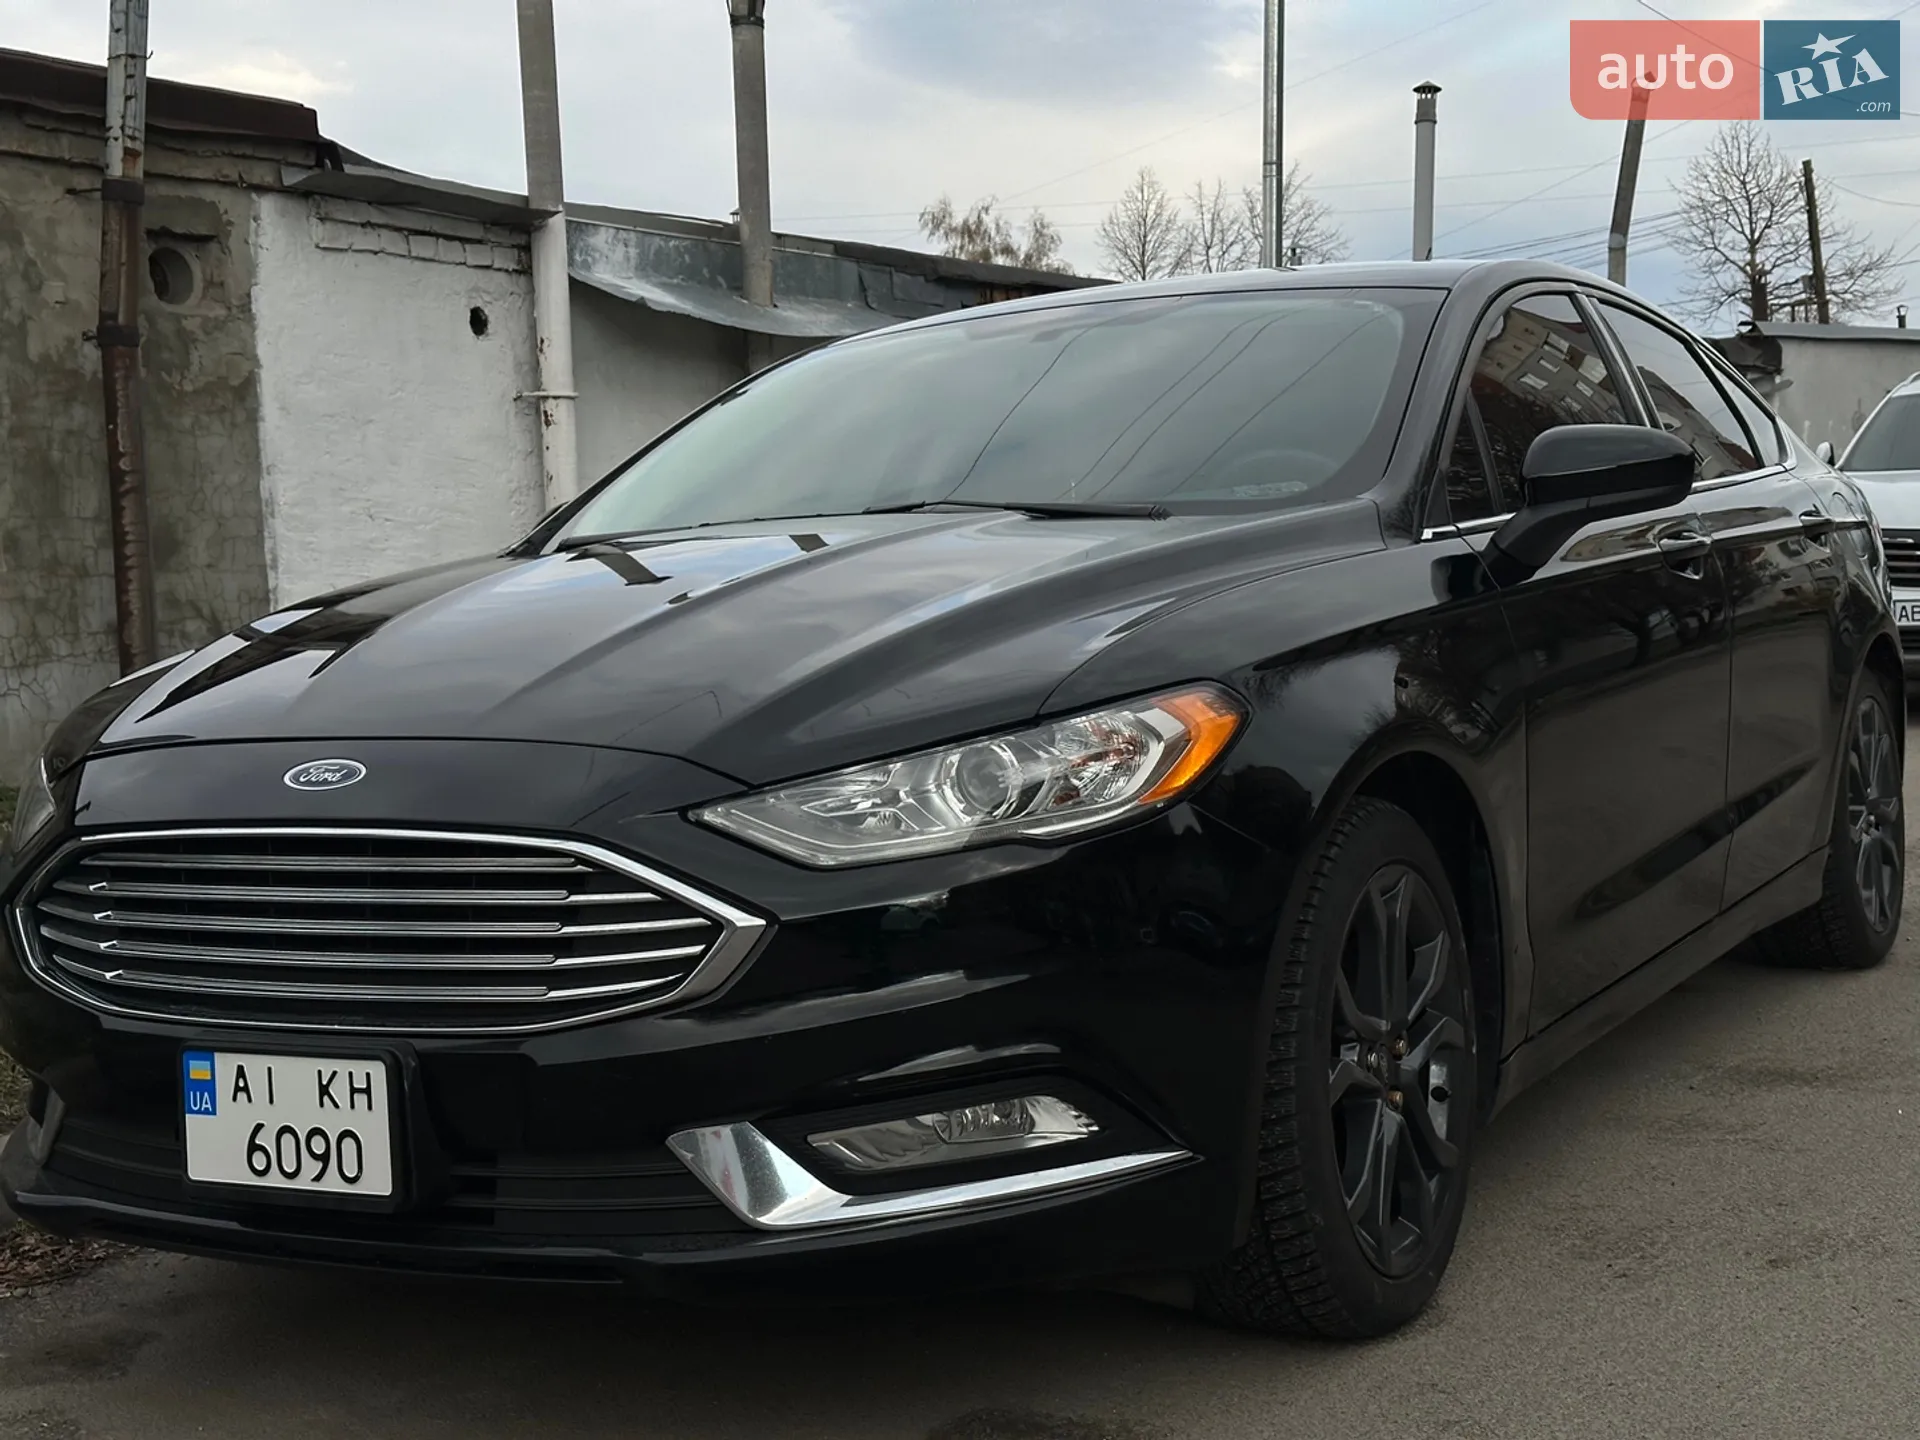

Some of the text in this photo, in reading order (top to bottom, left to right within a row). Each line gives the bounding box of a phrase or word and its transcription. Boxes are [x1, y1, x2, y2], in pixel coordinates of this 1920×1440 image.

[299, 765, 348, 782] Ford
[190, 1091, 212, 1112] UA
[232, 1064, 373, 1111] AI KH
[246, 1122, 364, 1185] 6090
